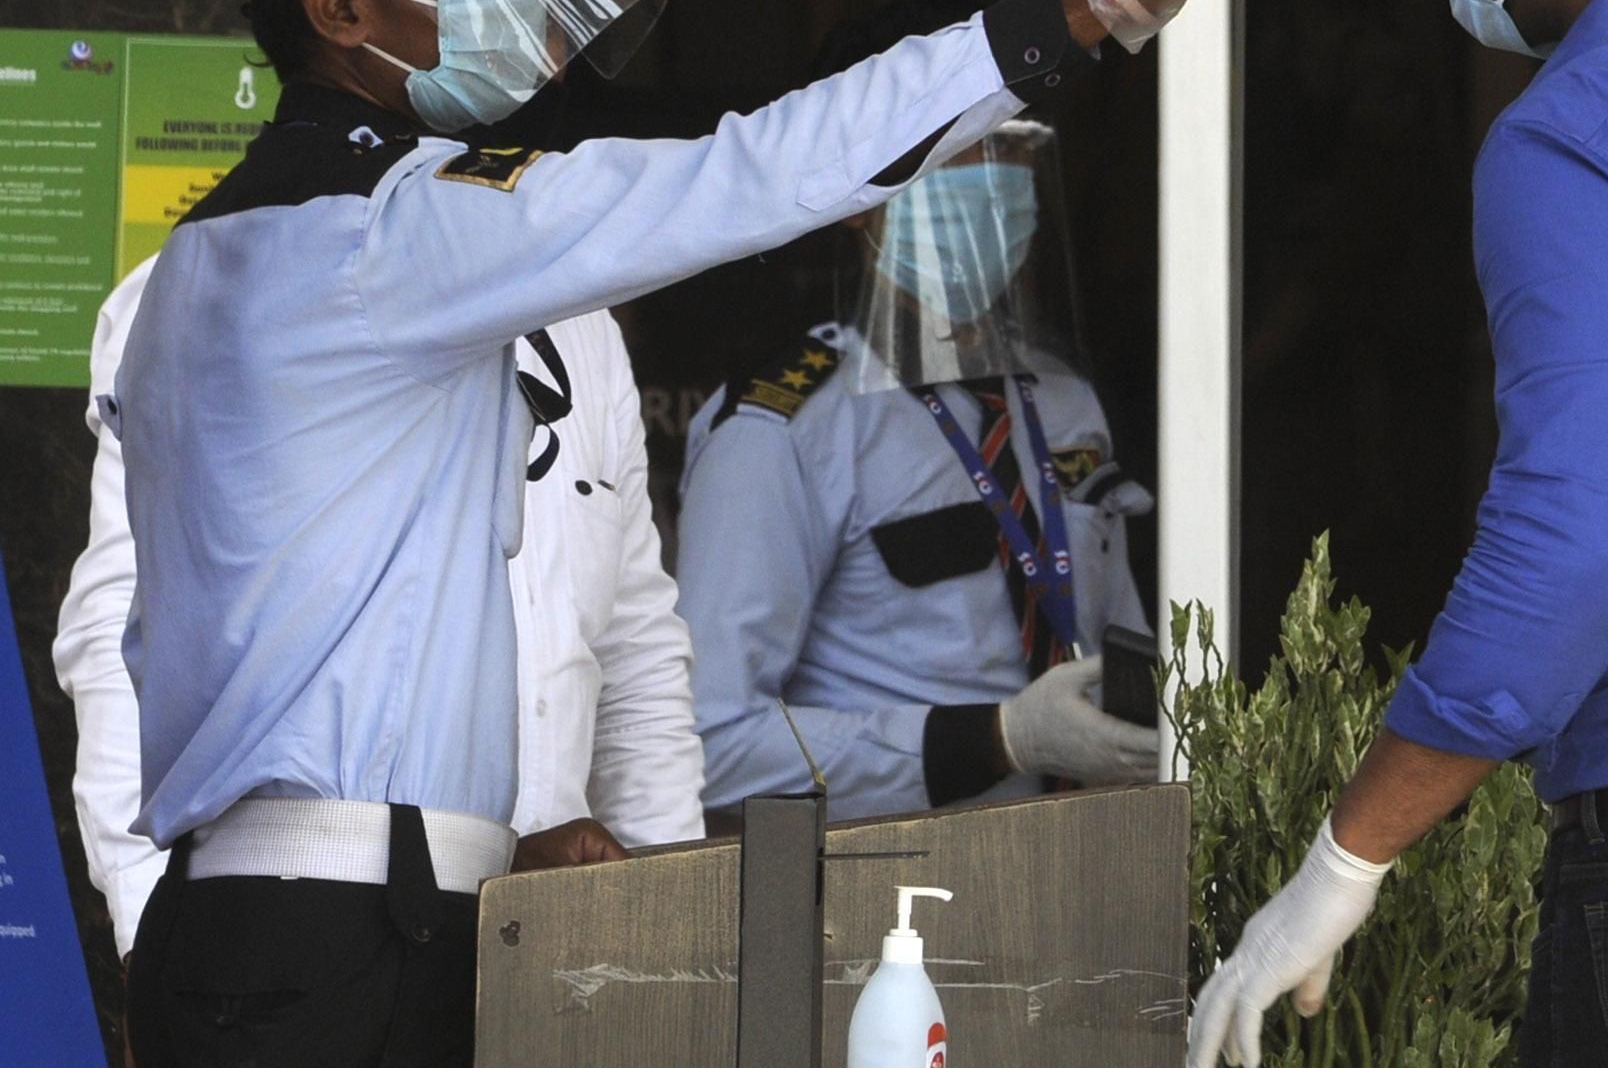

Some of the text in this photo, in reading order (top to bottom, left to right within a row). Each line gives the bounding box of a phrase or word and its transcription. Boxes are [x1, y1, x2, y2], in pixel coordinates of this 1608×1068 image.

[163, 120, 218, 134] EVERYONE
[221, 122, 232, 134] IS
[135, 136, 241, 152] FOLLOWING BEFORE
